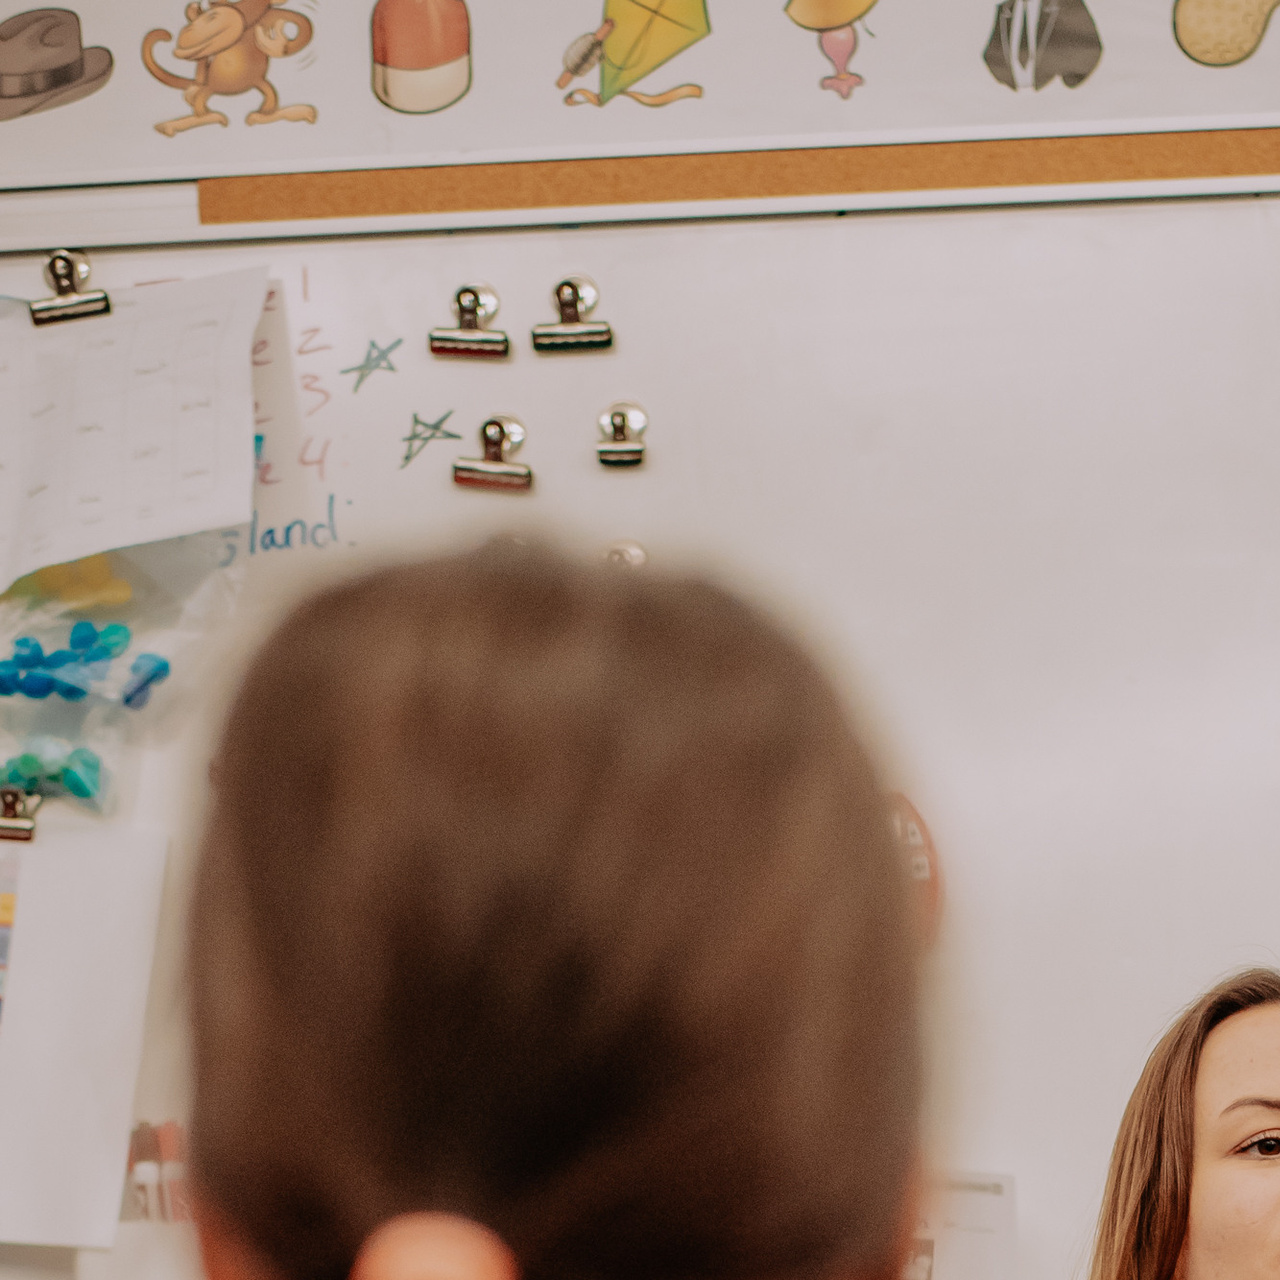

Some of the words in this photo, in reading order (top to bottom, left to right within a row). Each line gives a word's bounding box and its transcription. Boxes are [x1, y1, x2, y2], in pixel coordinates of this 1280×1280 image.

[297, 327, 333, 356] 2
[300, 374, 332, 417] 3
[299, 437, 331, 482] 4
